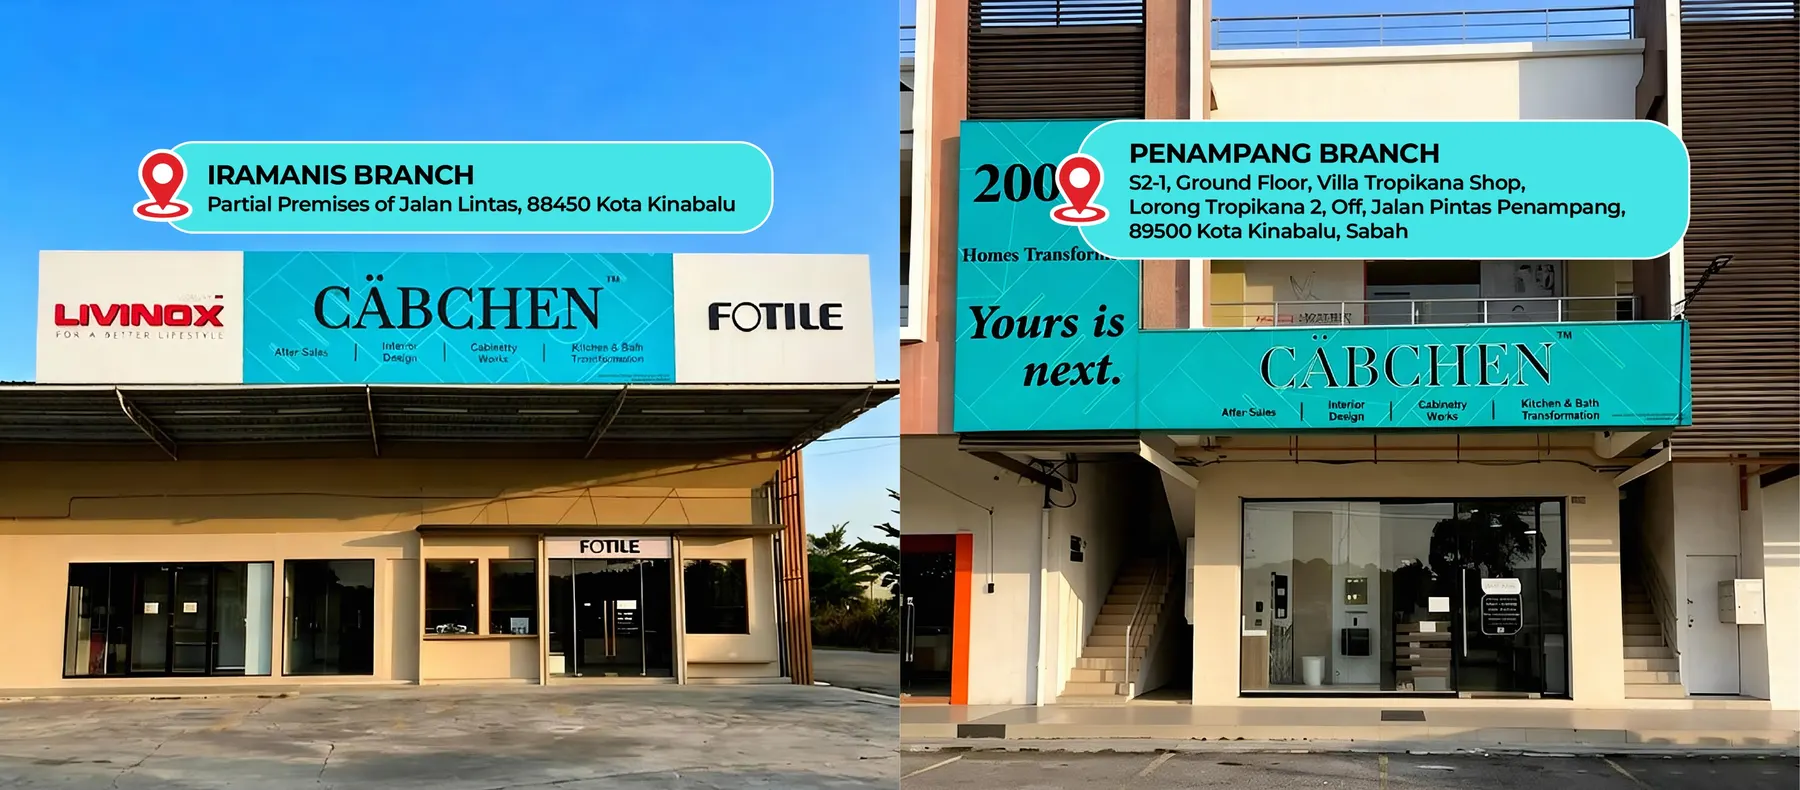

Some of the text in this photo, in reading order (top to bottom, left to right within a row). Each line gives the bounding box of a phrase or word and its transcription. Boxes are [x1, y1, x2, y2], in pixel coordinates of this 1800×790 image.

[963, 247, 1019, 263] Homes
[314, 273, 605, 330] CÄBCHEN
[54, 303, 225, 328] LIVINOX
[708, 301, 844, 333] FOTILE
[969, 304, 1125, 340] Yours is
[55, 330, 80, 339] FOR
[1259, 333, 1557, 390] CÄBCHEN
[1023, 354, 1121, 387] next.
[1328, 399, 1366, 410] Interior
[1521, 398, 1600, 409] Kitchen & Bath
[1328, 411, 1365, 423] Design
[1426, 411, 1459, 421] Works
[1521, 410, 1600, 421] Transformation
[579, 539, 641, 554] FOTILE
